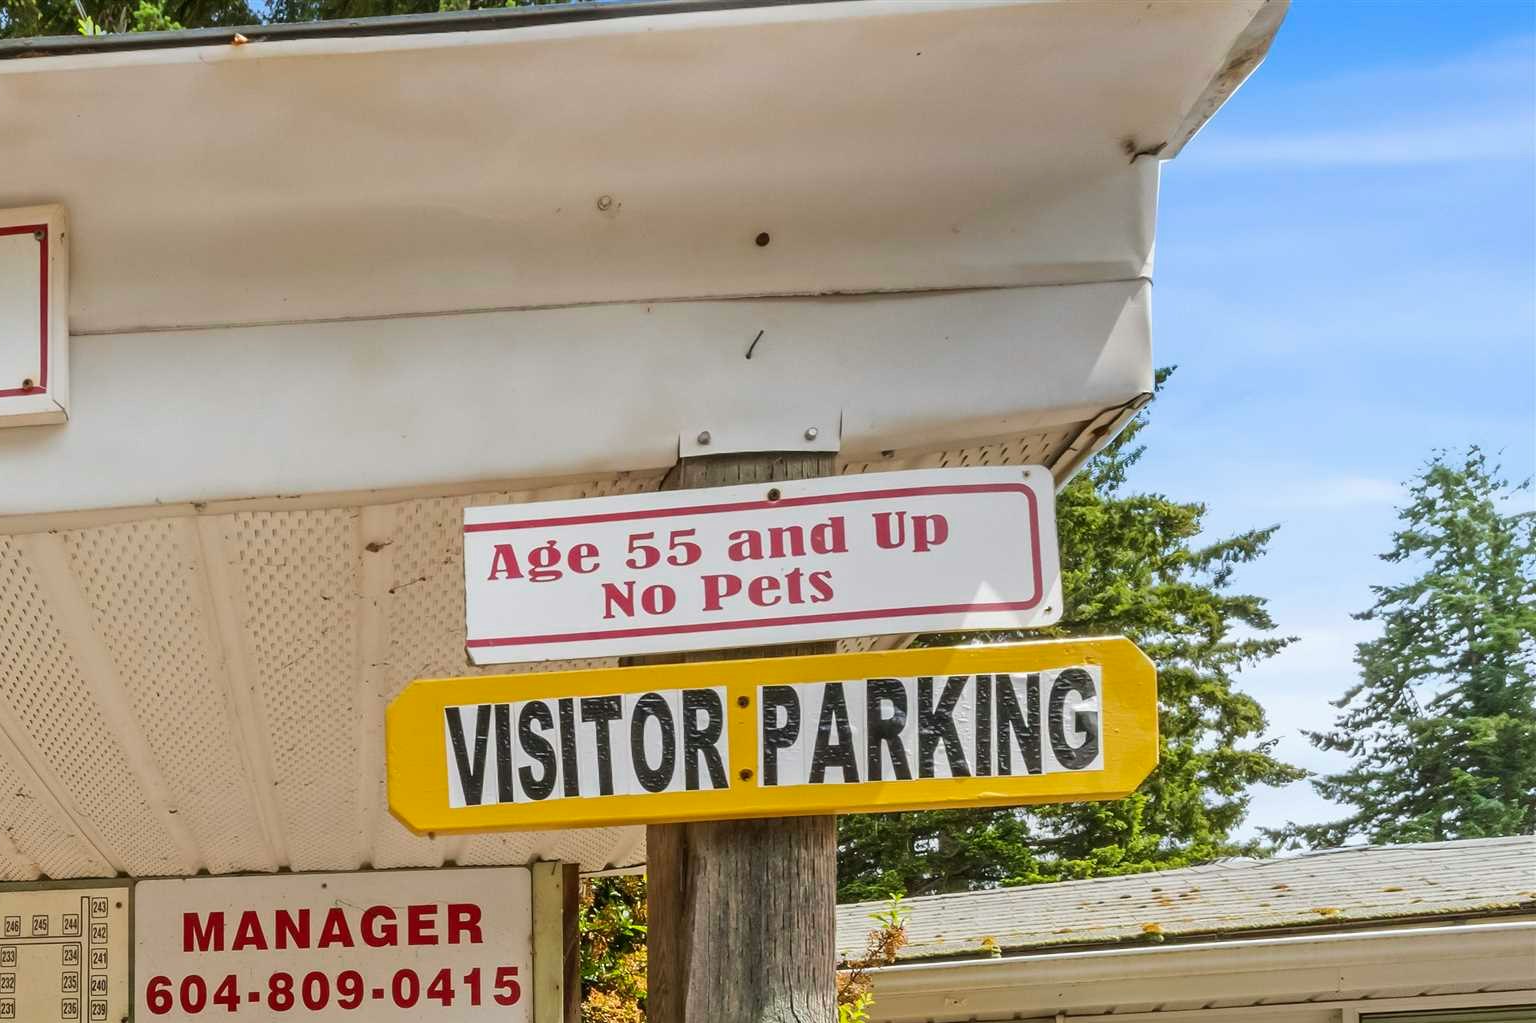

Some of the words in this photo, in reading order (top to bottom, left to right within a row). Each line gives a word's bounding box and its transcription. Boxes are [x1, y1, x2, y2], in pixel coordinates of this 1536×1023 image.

[487, 539, 600, 582] Age
[626, 528, 702, 568] 55
[728, 515, 846, 562] and
[872, 509, 949, 552] Up
[602, 580, 677, 620] No
[702, 566, 835, 611] Pets
[445, 685, 730, 808] VISITOR
[762, 667, 1100, 786] PARKING
[93, 901, 106, 913] 243
[34, 919, 46, 931] 245
[183, 903, 484, 952] MANAGER
[64, 950, 77, 960] 234
[93, 953, 106, 964] 241
[146, 966, 521, 1014] 604-809-0415
[92, 1004, 105, 1015] 239
